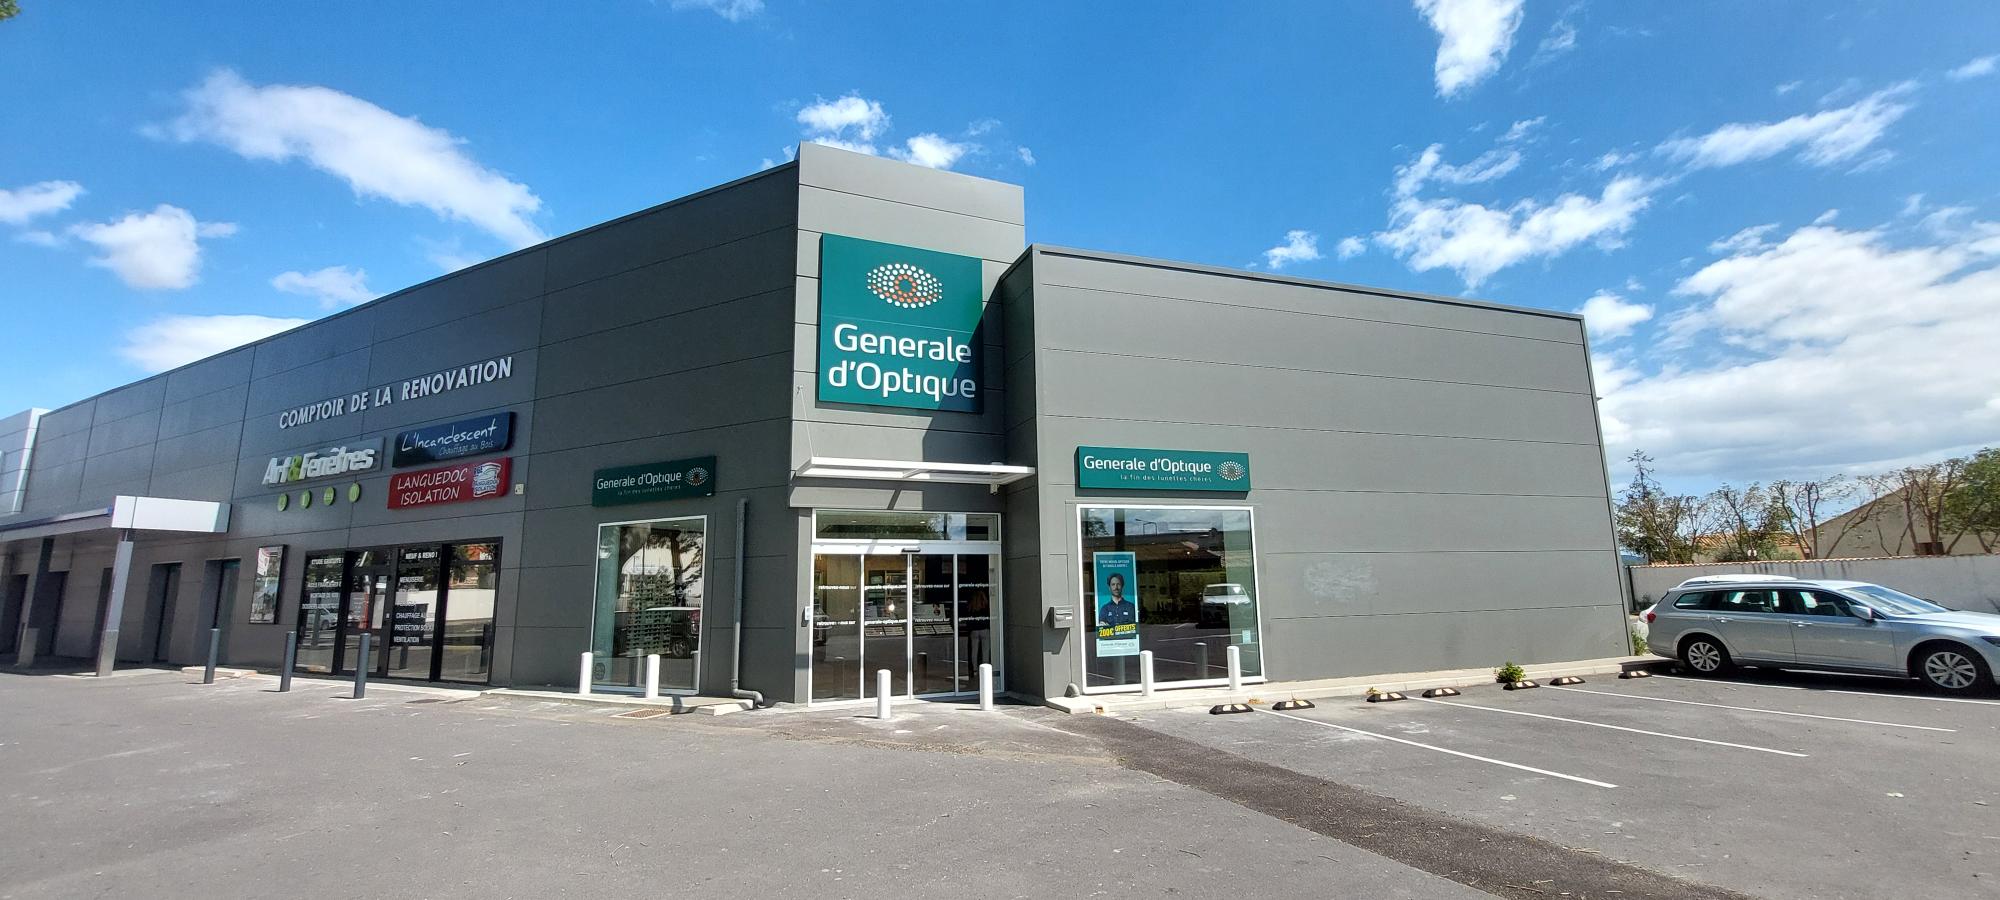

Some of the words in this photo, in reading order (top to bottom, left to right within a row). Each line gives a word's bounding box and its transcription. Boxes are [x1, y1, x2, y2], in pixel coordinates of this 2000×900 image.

[834, 323, 972, 363] Generale
[828, 360, 976, 402] d'Optique
[279, 398, 345, 429] COMPTOIR
[350, 391, 369, 412] DE
[374, 386, 392, 407] LA
[401, 356, 513, 401] RENOVATION
[401, 418, 498, 452] L'Incandescent
[480, 440, 493, 450] Bois
[1083, 455, 1146, 471] Generale
[1149, 458, 1212, 475] d'Optique
[397, 468, 468, 490] LANGUEDOC
[597, 475, 636, 490] Generale
[637, 472, 682, 486] d'Optique
[401, 486, 460, 506] ISOLATION
[1099, 628, 1114, 637] 200€
[1115, 624, 1136, 632] OFFERTS
